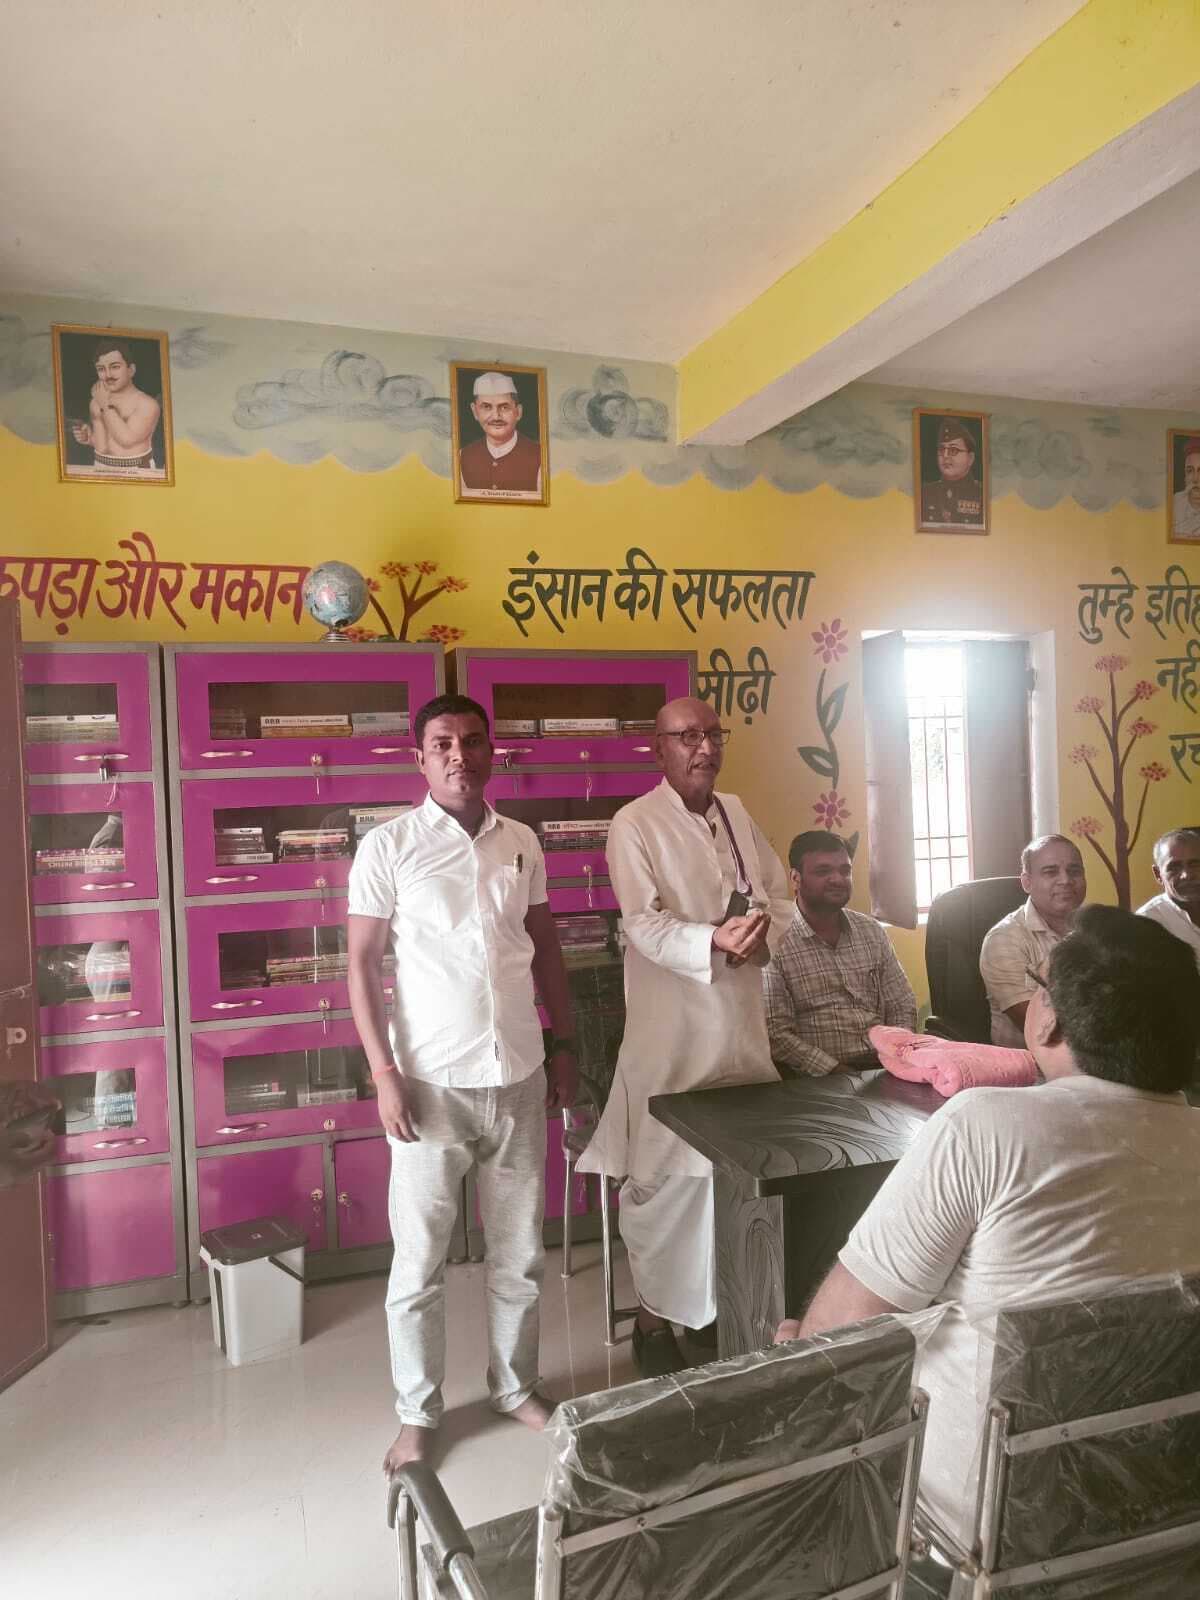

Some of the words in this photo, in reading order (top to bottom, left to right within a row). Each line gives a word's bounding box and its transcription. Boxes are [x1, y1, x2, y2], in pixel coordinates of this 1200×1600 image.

[97, 531, 187, 630] और
[190, 562, 311, 625] मकान
[502, 550, 613, 637] इंसान
[614, 547, 668, 622] की
[672, 568, 816, 634] सफलता
[1078, 566, 1139, 644] तुम्हे
